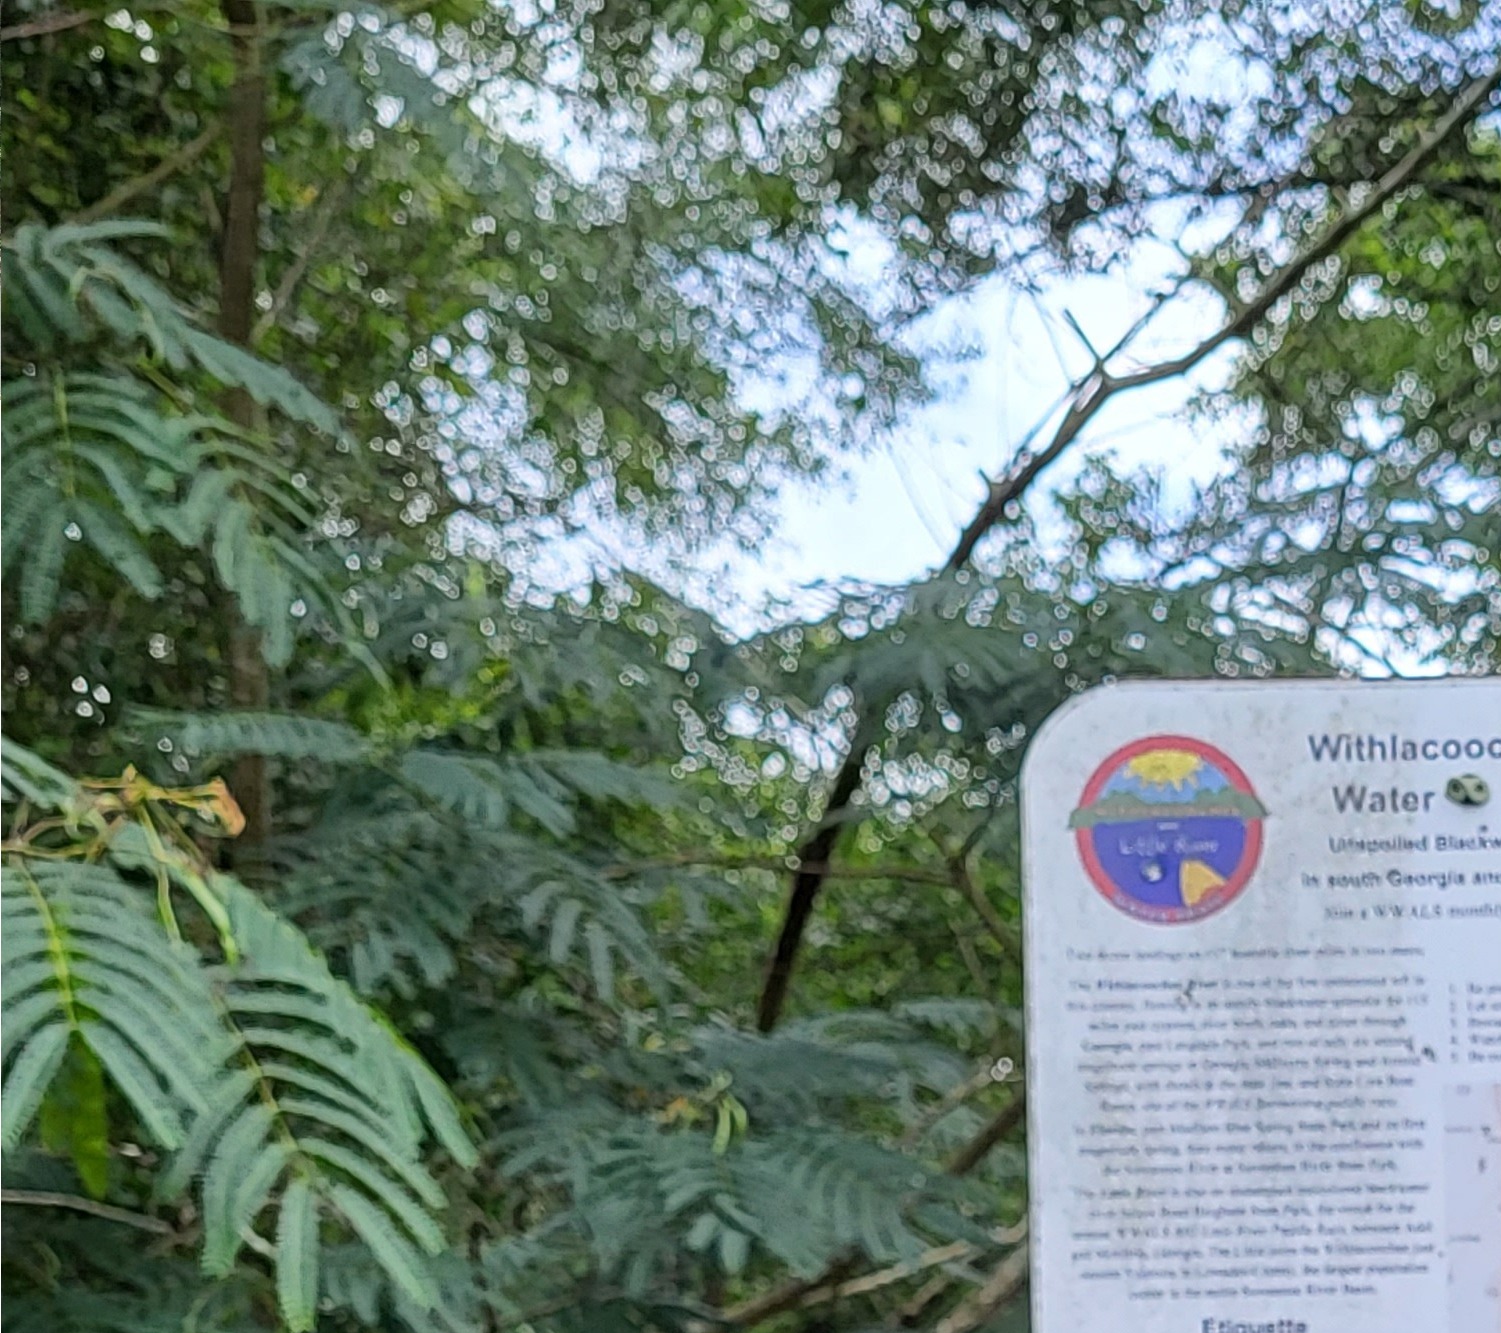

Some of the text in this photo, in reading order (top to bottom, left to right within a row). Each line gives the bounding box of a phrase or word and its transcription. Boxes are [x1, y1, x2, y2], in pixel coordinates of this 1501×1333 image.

[1332, 784, 1435, 813] Water
[1328, 869, 1381, 888] south
[1386, 868, 1464, 890] Georgia
